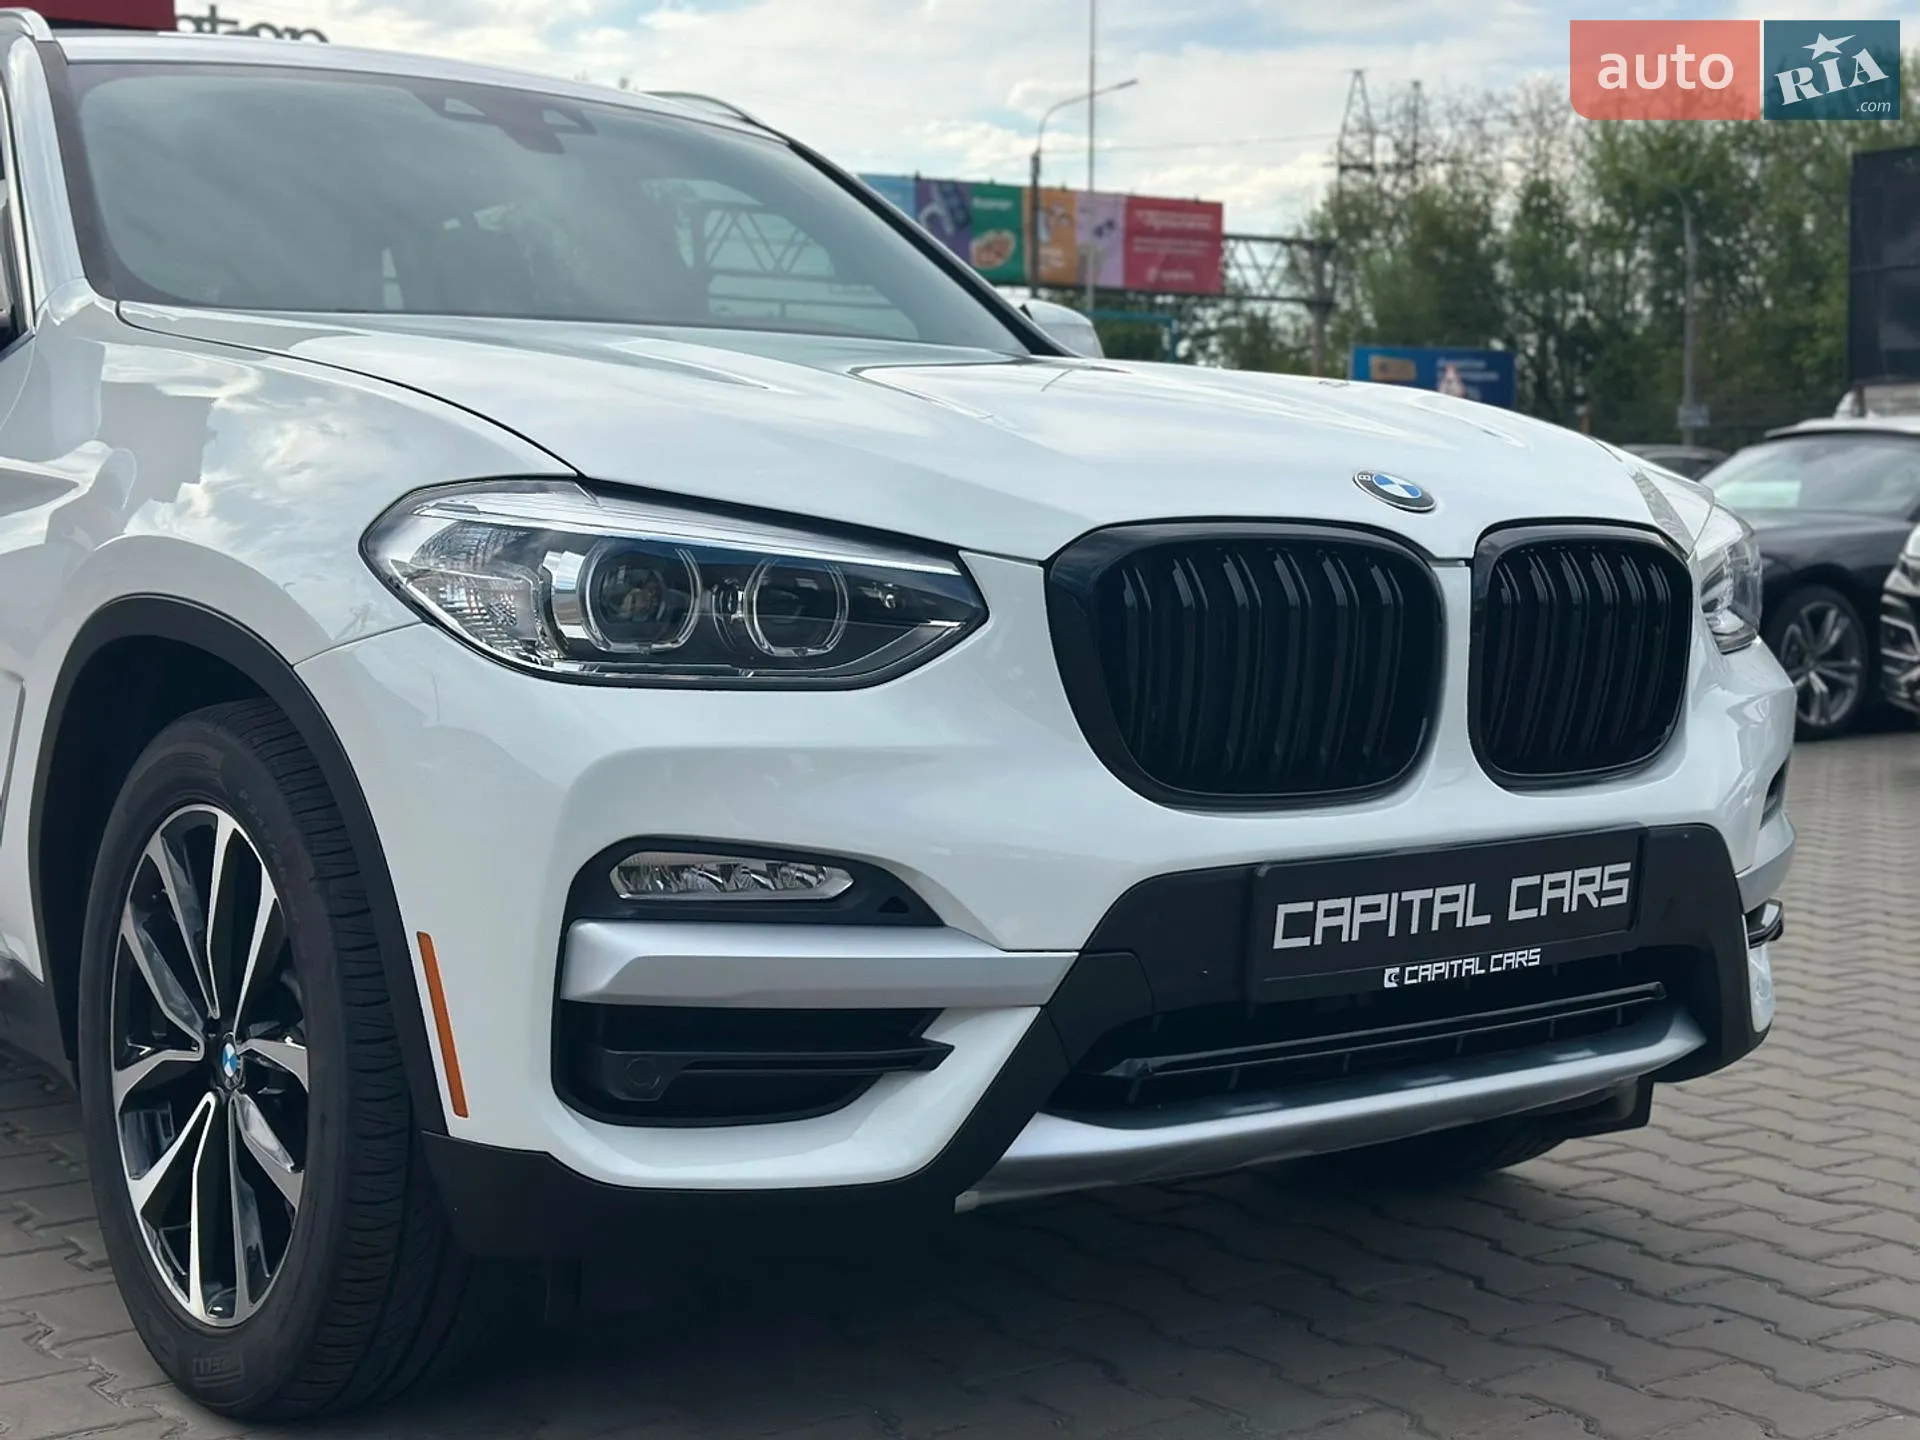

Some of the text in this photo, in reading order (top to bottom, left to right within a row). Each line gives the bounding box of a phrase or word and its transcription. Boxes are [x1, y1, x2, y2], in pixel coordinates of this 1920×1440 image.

[1272, 861, 1632, 950] CAPITAL CARS
[1403, 947, 1542, 986] CAPITAL CARS
